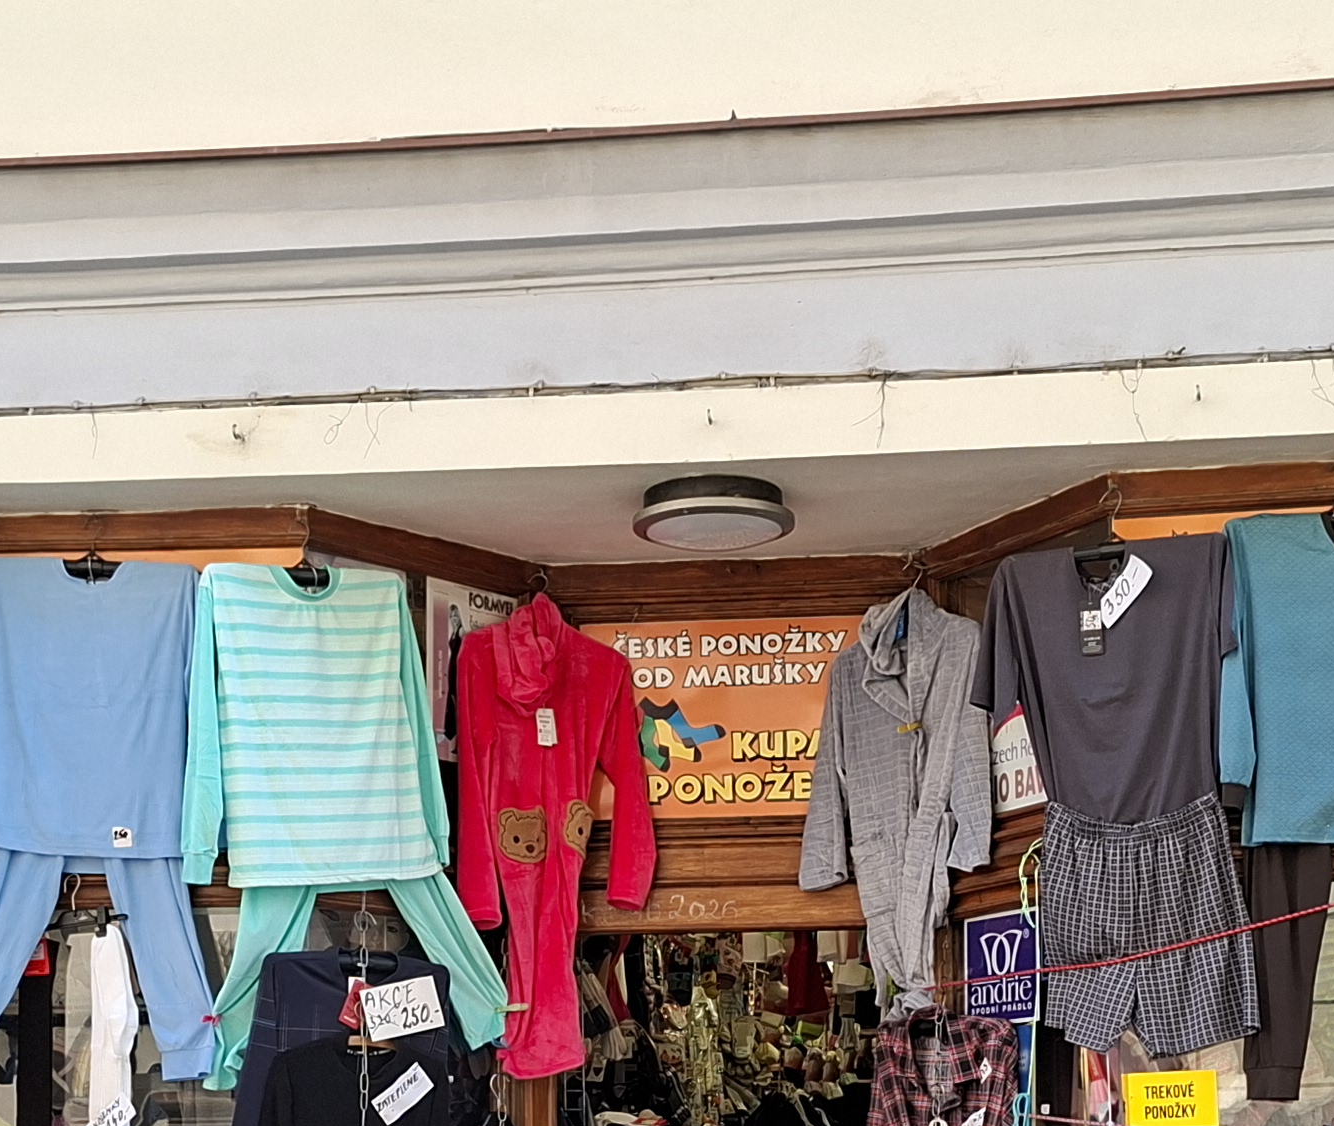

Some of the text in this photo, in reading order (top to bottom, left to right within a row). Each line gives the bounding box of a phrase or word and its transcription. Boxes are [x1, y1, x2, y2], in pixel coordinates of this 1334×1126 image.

[613, 624, 848, 659] ČESKÉ PONOŽKY
[632, 657, 828, 689] OD MARUŠKY
[365, 982, 417, 1009] AKCE
[970, 976, 1032, 1006] andrie
[1002, 1001, 1032, 1012] PRÁDLO
[1144, 1081, 1195, 1099] TREKOVÉ
[1145, 1102, 1196, 1119] PONOŽKY
